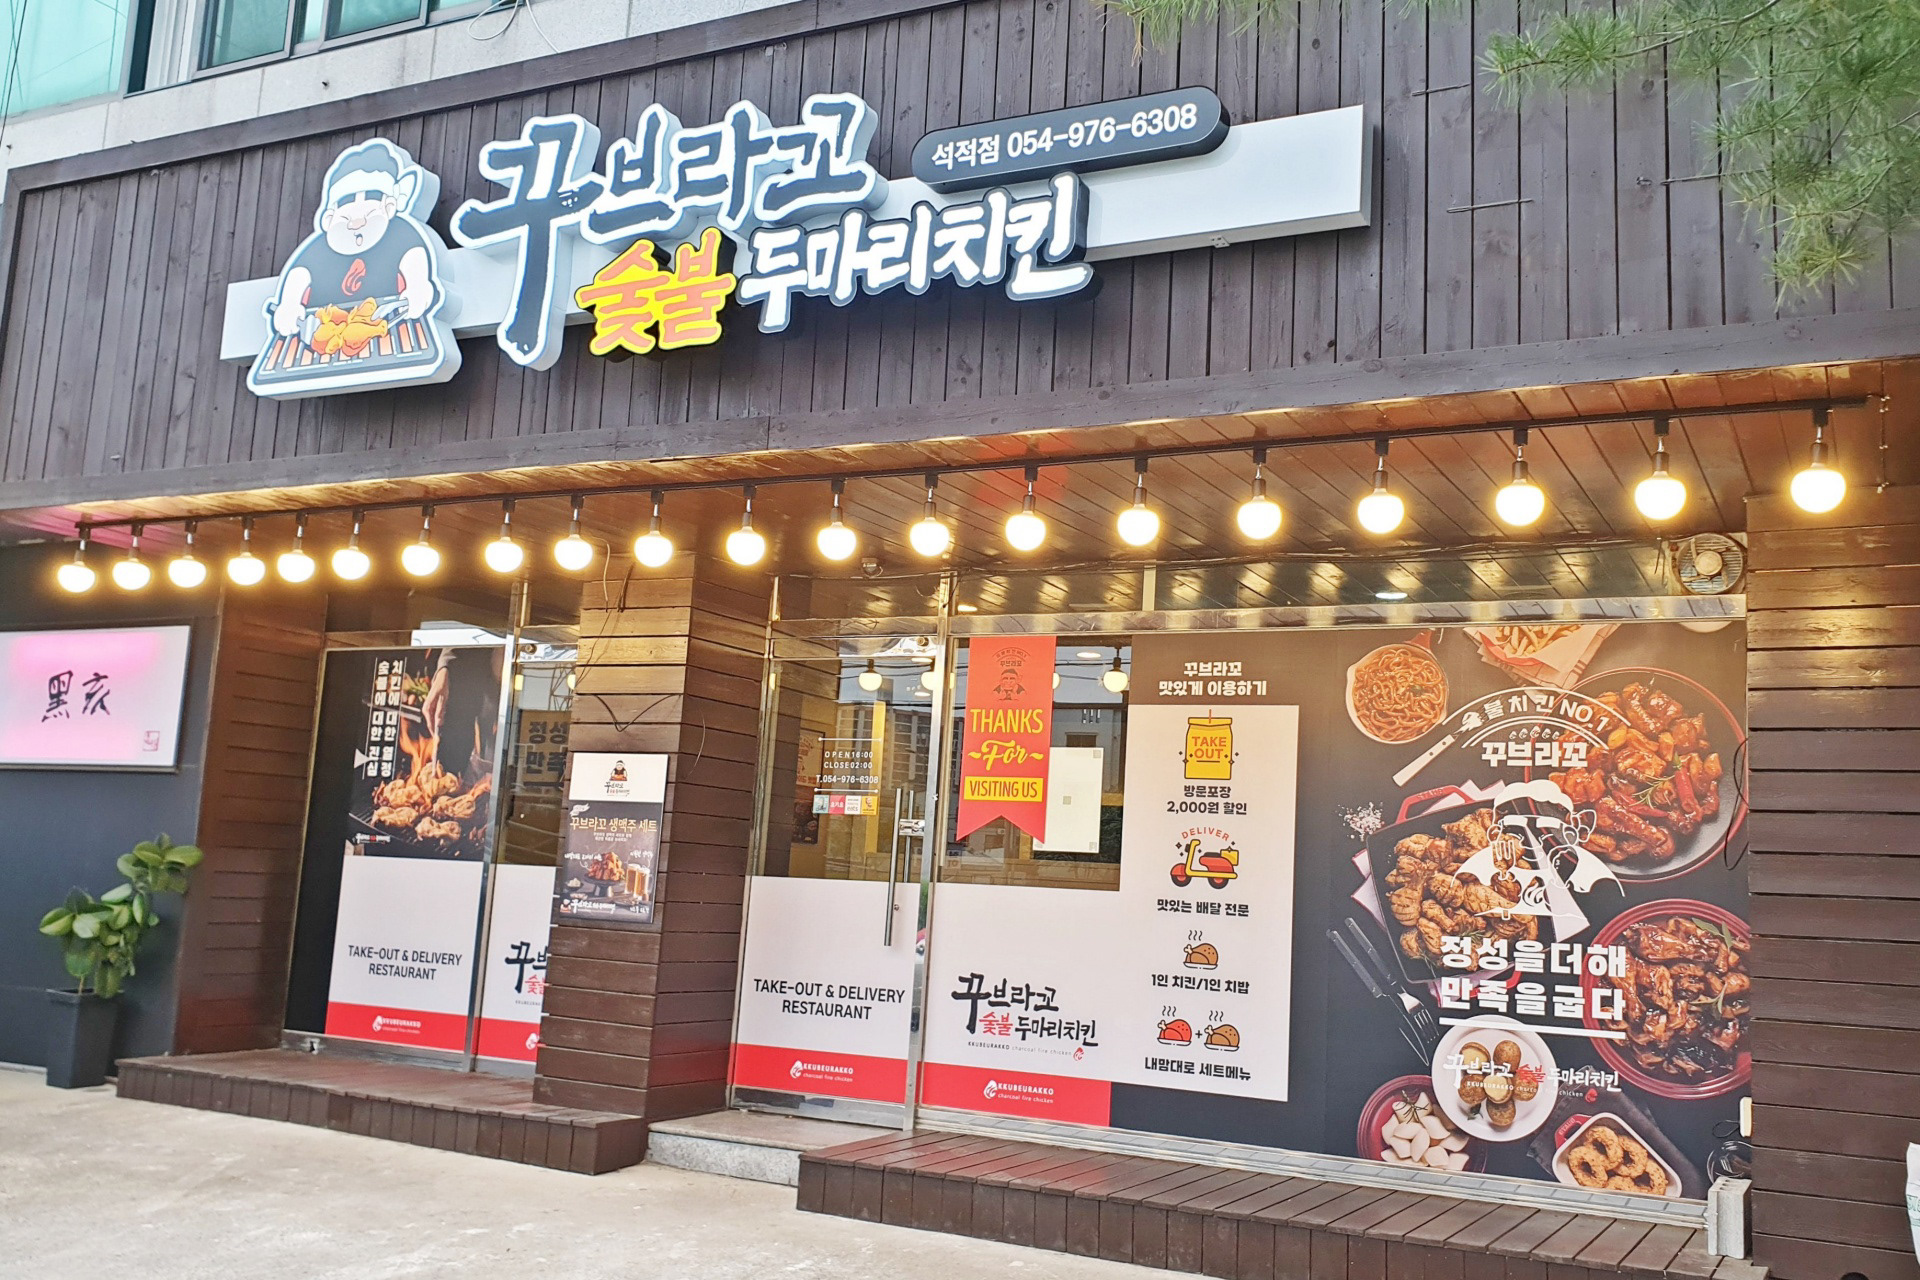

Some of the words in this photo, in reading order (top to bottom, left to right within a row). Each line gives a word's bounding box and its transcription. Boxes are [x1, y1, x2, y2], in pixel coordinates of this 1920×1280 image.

[931, 134, 1001, 171] 석적점
[1007, 103, 1197, 159] 054-976-6308
[452, 96, 870, 362] 꾸브라꼬
[577, 229, 734, 352] 숯불
[736, 172, 1090, 329] 두마리치킨
[1184, 661, 1242, 677] 꾸브라꼬
[388, 660, 403, 707] 치킨에
[1158, 680, 1203, 697] 맛있게
[1207, 680, 1267, 696] 이용하기
[384, 710, 398, 742] 대한
[970, 708, 1044, 734] THANKS
[1559, 699, 1610, 732] NO.1
[370, 711, 385, 742] 대한
[1191, 736, 1227, 747] TAKE
[367, 745, 381, 777] 진심
[381, 746, 394, 777] 열정
[825, 751, 850, 759] OPEN
[981, 739, 1028, 771] For
[1194, 748, 1223, 759] OUT
[1481, 741, 1588, 768] 꾸브라꼬
[824, 761, 849, 769] CLOSE
[816, 774, 879, 784] T.054-976-6308
[970, 780, 1019, 798] VISITING
[1022, 781, 1038, 798] US
[1184, 785, 1231, 799] 방문포장
[1167, 801, 1219, 815] 2,000원
[1223, 802, 1247, 815] 할인
[569, 816, 607, 832] 꾸브라꼬
[608, 817, 637, 833] 생맥주
[638, 819, 657, 833] 세트
[1181, 827, 1230, 842] DELIVER
[1157, 899, 1192, 913] 맛있는
[1196, 901, 1222, 916] 배달
[1224, 902, 1249, 917] 전문
[348, 945, 400, 960] TAKE-OUT
[402, 950, 409, 961] &
[412, 950, 462, 966] DELIVERY
[368, 964, 437, 980] RESTAURANT
[753, 978, 823, 997] TAKE-OUT
[825, 985, 834, 998] &
[838, 985, 905, 1004] DELIVERY
[1151, 974, 1168, 987] 1인
[1171, 975, 1221, 992] 치킨/1인
[1224, 980, 1250, 995] 치밥
[782, 1000, 872, 1020] RESTAURANT
[951, 972, 1059, 1035] 꾸브라꼬
[979, 1011, 1013, 1036] 숯불
[1015, 1014, 1099, 1047] 두마리치킨
[1145, 1056, 1195, 1075] 내맘대로
[1199, 1062, 1251, 1081] 세트메뉴
[1443, 1054, 1514, 1090] 꾸브라꼬
[1547, 1067, 1622, 1092] 두마리치킨
[998, 1082, 1054, 1095] KKUBEURAKKO
[1033, 1096, 1053, 1104] chicken
